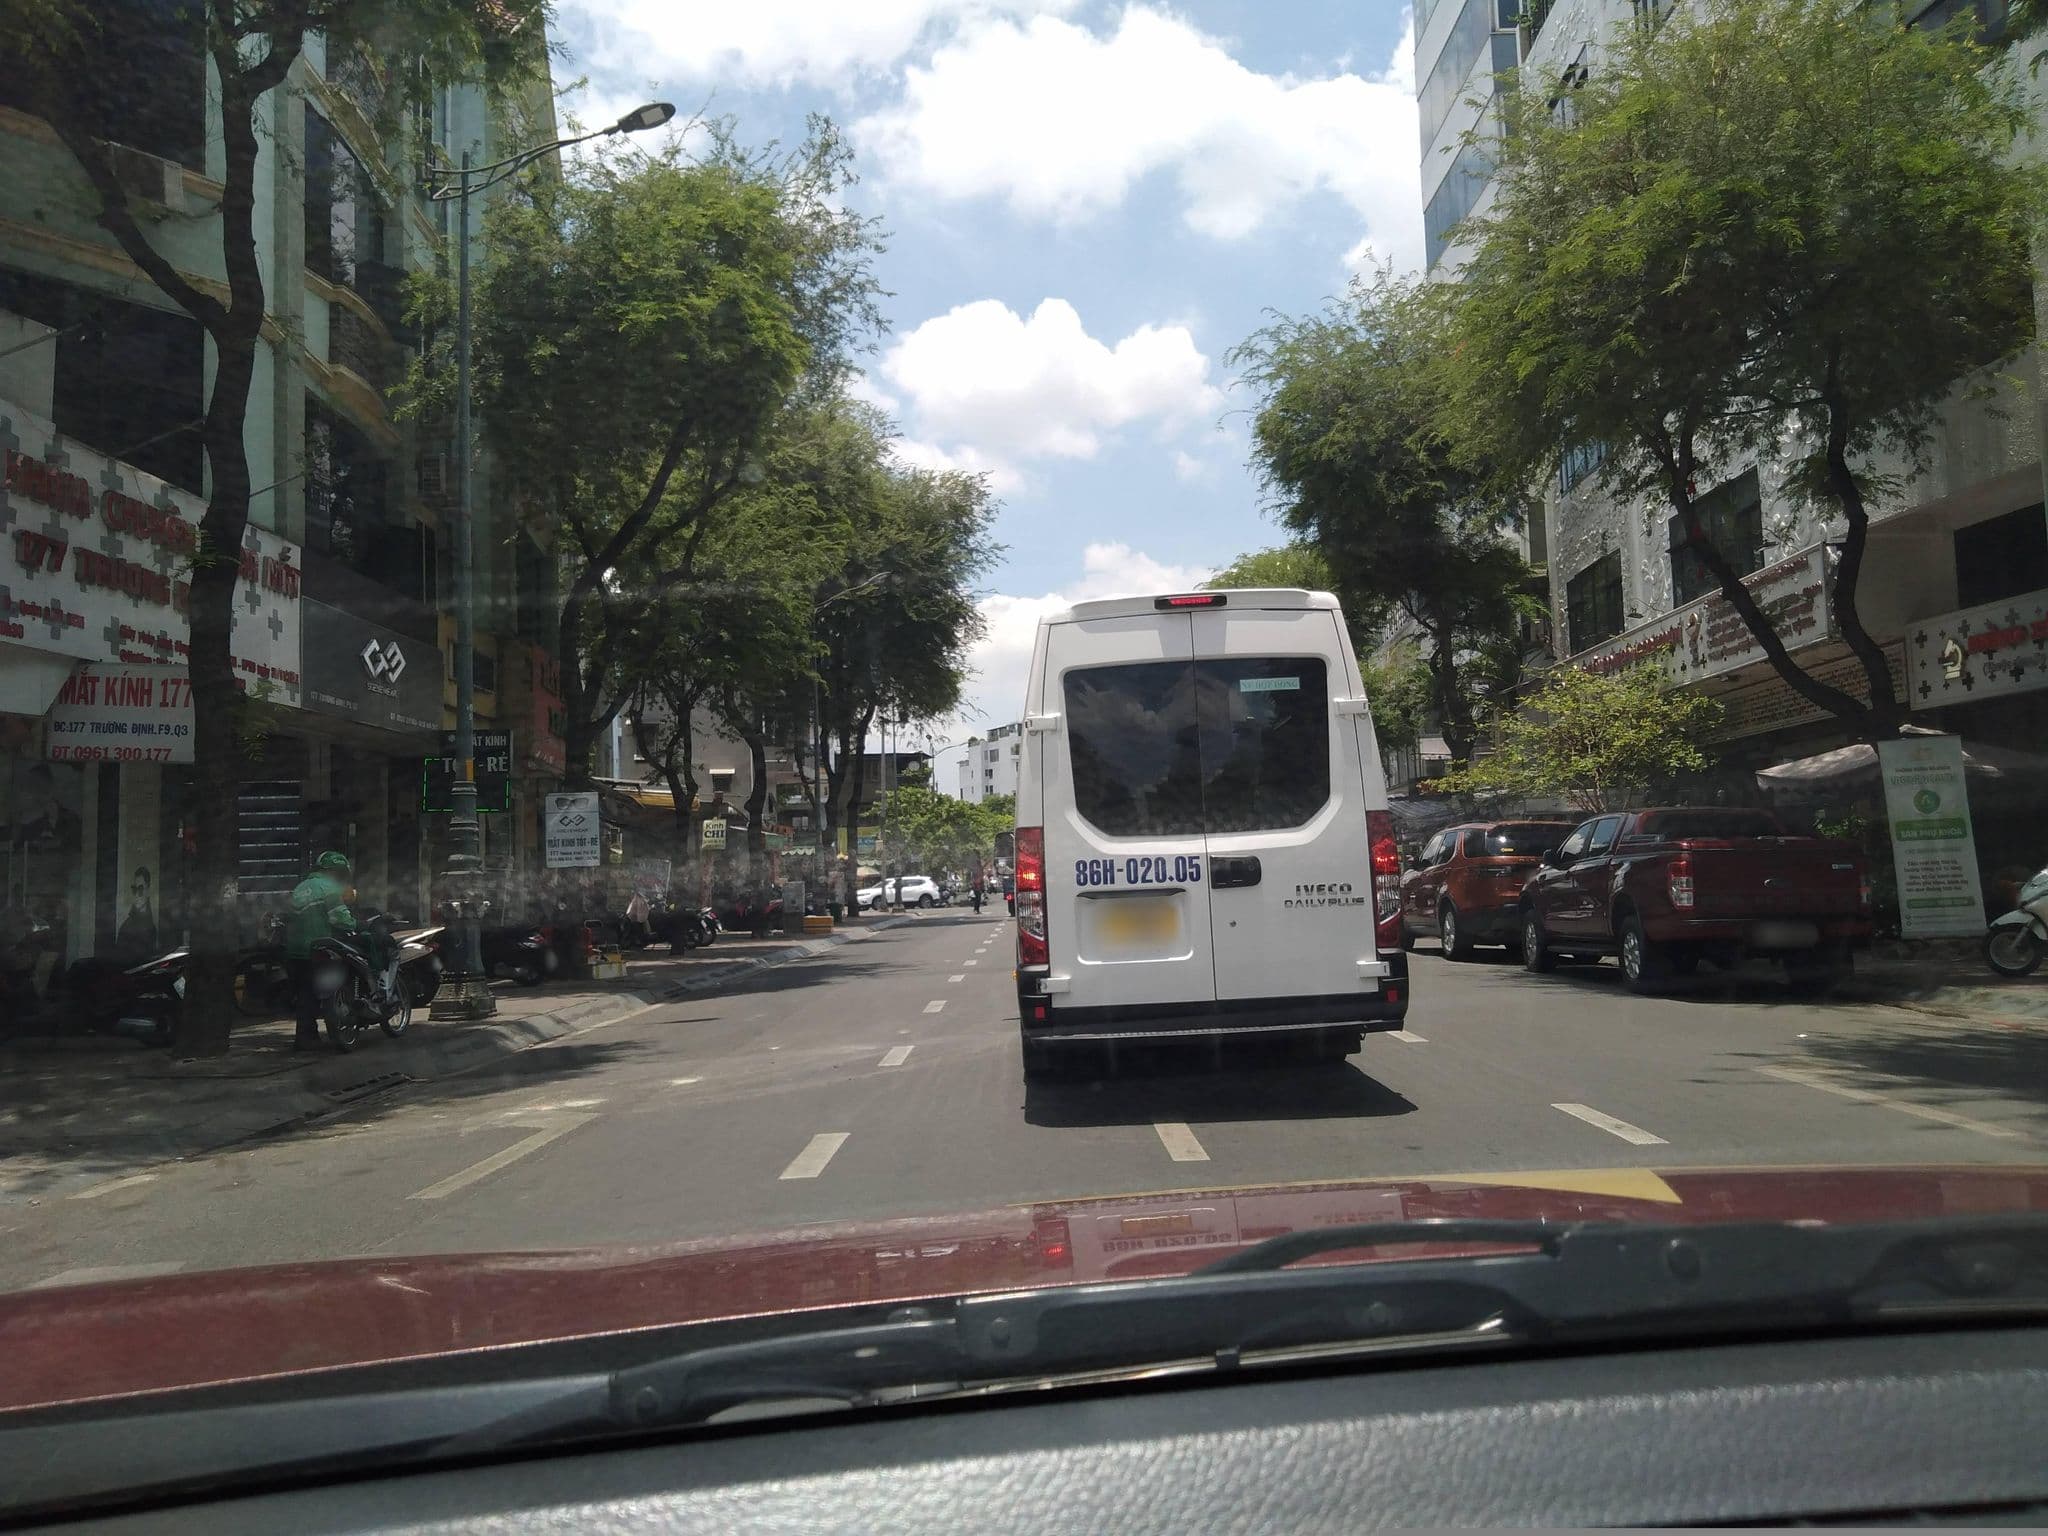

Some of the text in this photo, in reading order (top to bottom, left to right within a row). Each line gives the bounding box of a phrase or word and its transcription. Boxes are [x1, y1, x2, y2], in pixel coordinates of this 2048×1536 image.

[104, 670, 153, 708] KÍNH
[159, 678, 192, 708] 177
[1075, 855, 1201, 887] 86H-020.05
[1295, 883, 1352, 896] IVECO
